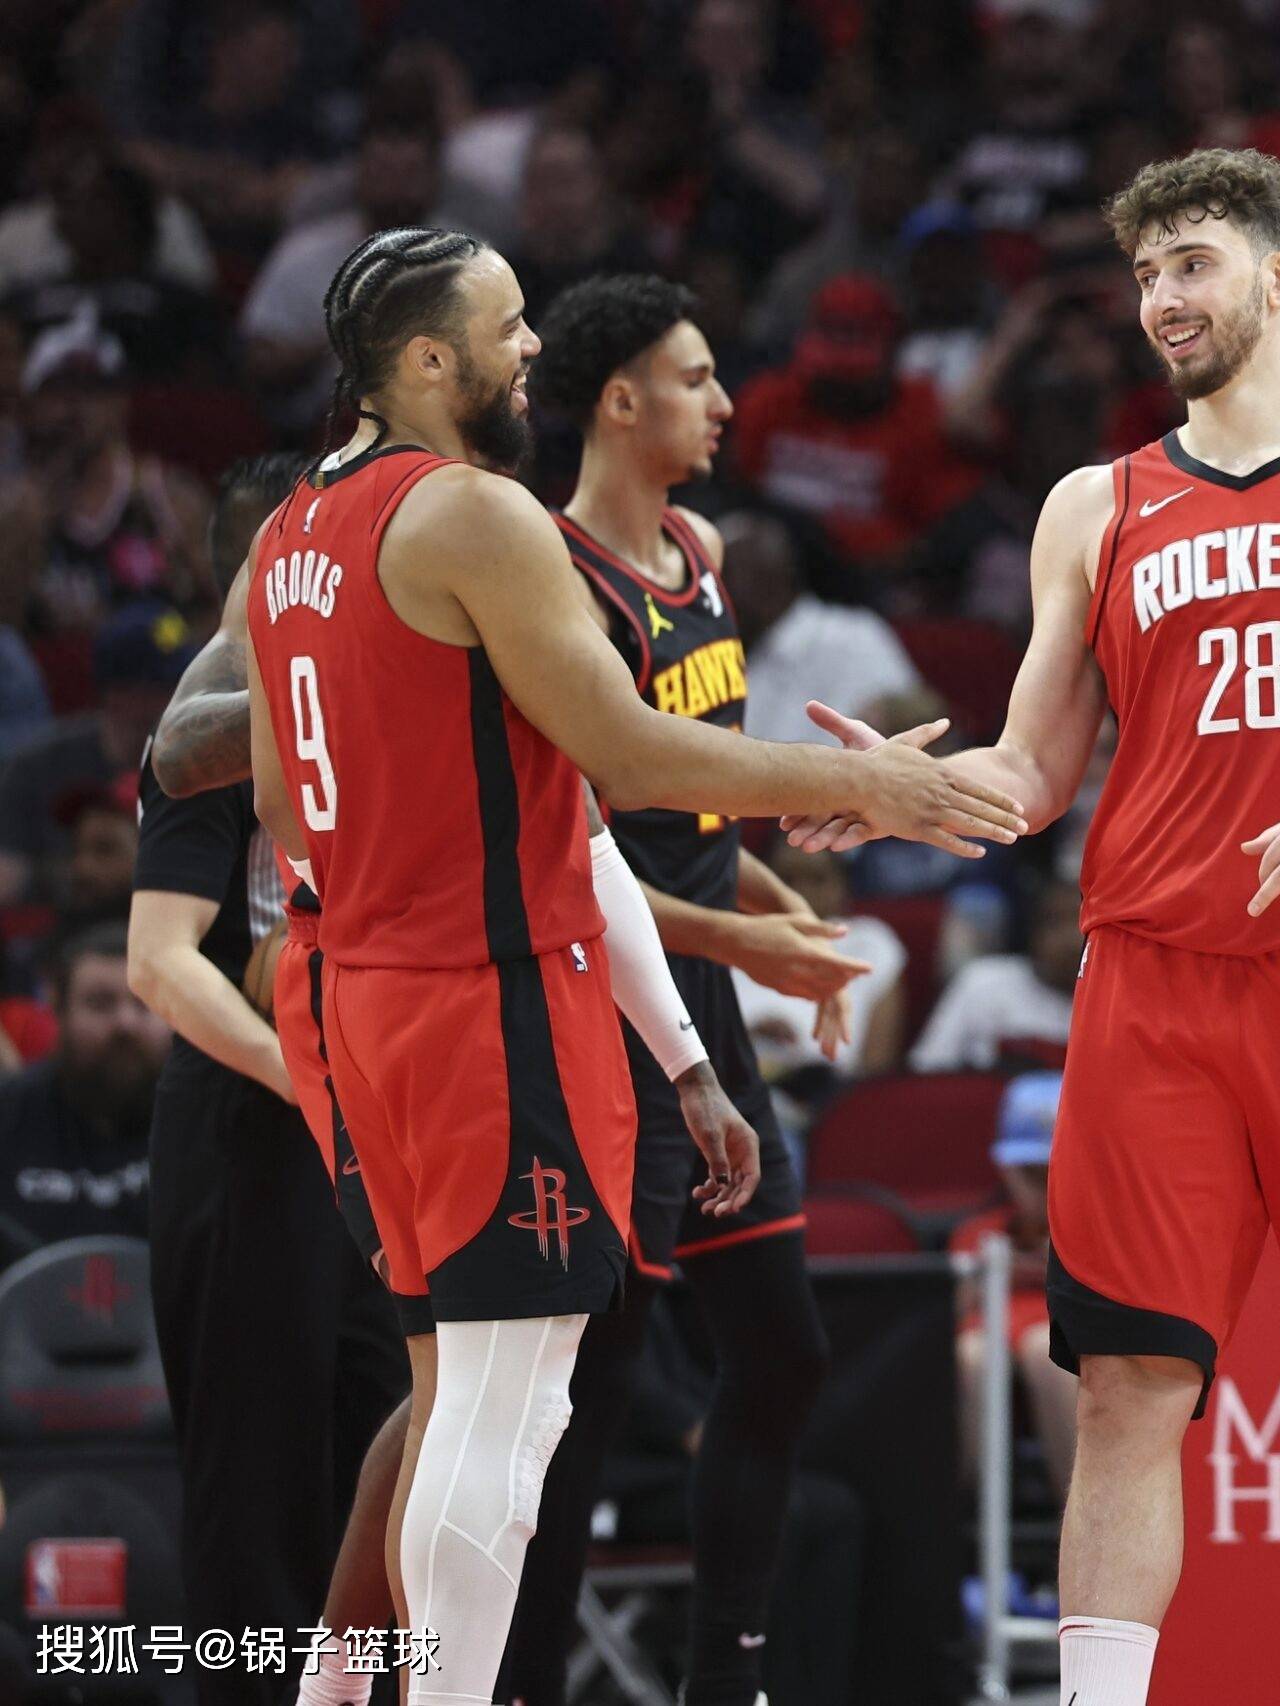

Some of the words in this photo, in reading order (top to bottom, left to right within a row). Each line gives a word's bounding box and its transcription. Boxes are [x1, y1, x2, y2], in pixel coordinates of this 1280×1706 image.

[265, 550, 343, 625] BROOKS
[654, 638, 748, 718] HAWK
[290, 656, 337, 832] 9
